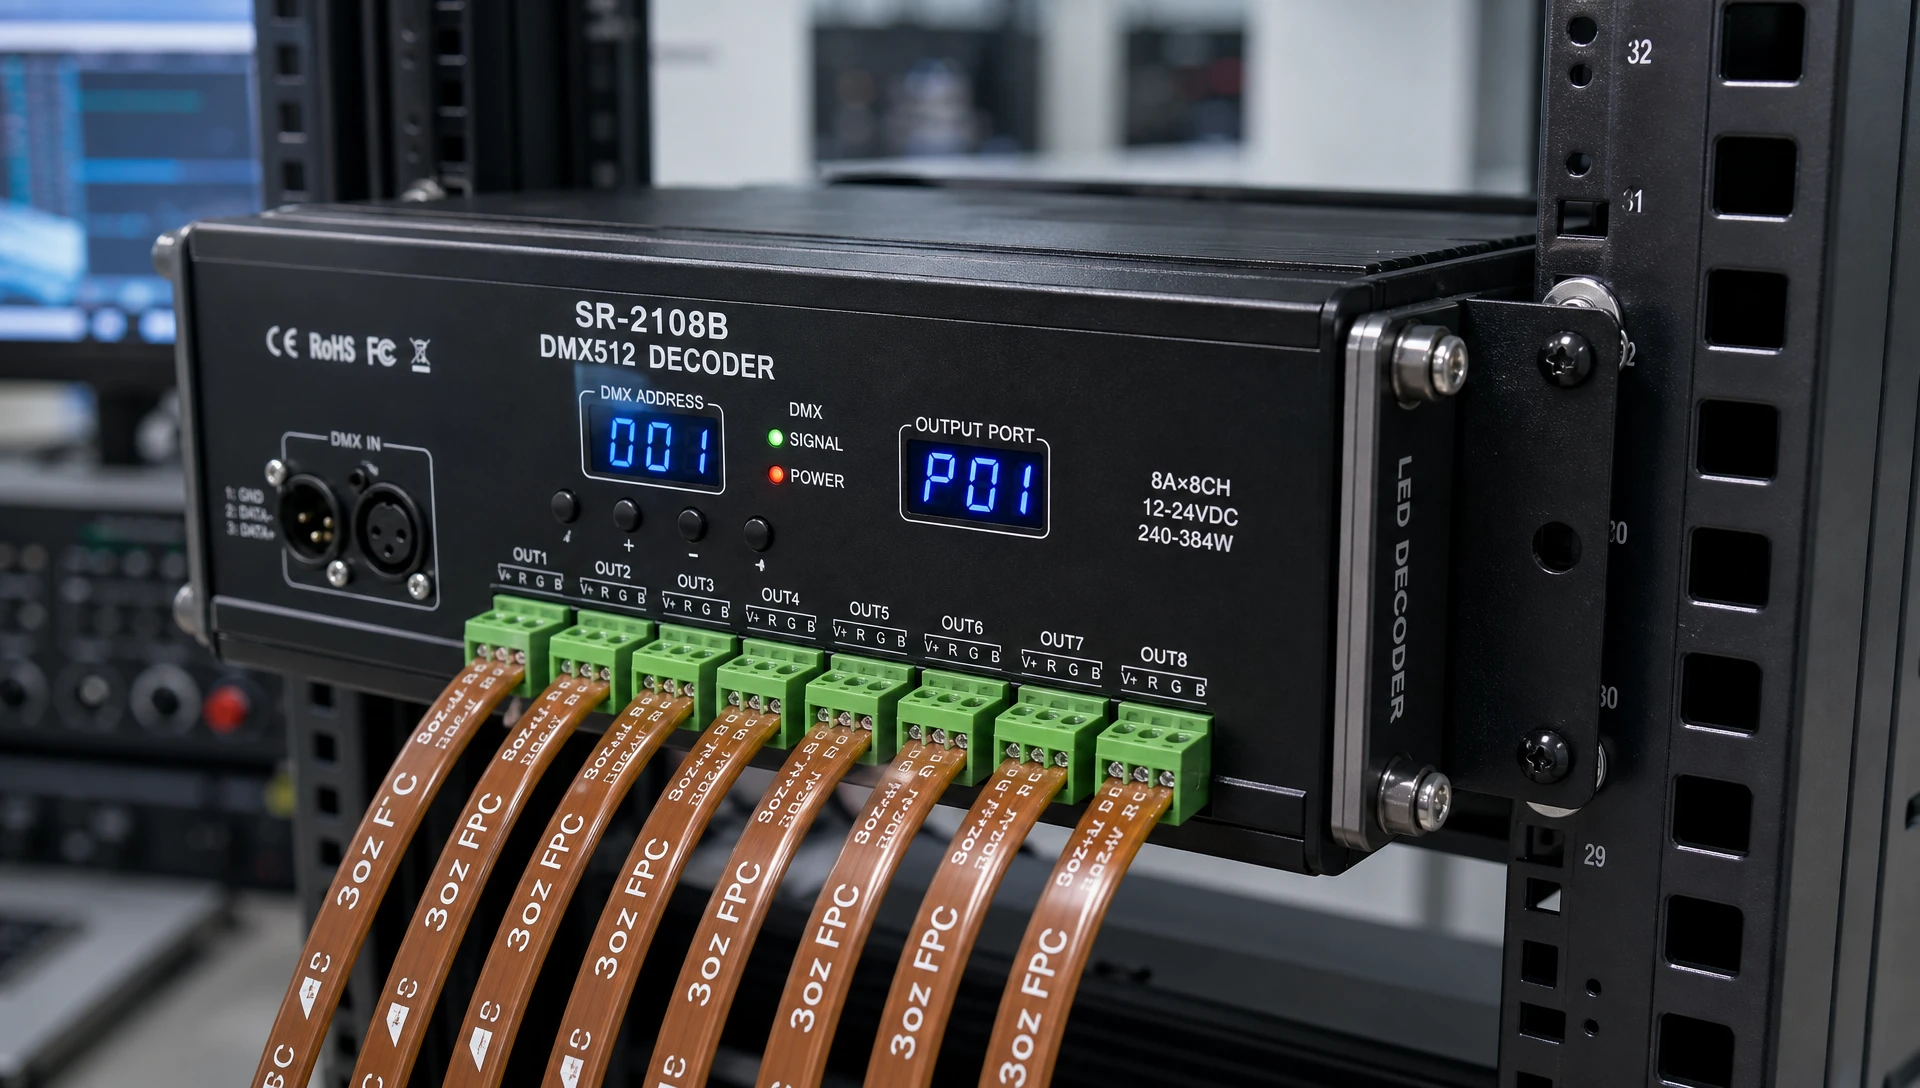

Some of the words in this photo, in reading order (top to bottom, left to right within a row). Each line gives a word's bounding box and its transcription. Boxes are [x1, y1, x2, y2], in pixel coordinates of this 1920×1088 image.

[1627, 39, 1652, 65] 32
[575, 300, 729, 340] SR-2108B
[266, 325, 298, 359] CE
[309, 332, 356, 363] RoHS
[540, 333, 636, 367] DMX512
[649, 344, 776, 381] DECODER
[600, 385, 632, 402] DMX
[636, 389, 704, 410] ADDRESS
[789, 401, 824, 420] DMX
[330, 431, 362, 449] DMX
[367, 435, 381, 451] IN
[789, 432, 844, 452] SIGNAL
[915, 416, 983, 439] OUTPUT
[988, 424, 1035, 444] PORT
[609, 417, 709, 475] 001
[790, 468, 845, 489] POWER
[923, 452, 1032, 515] P01
[1397, 455, 1412, 528] LED
[1143, 497, 1239, 527] 12-24VDC
[1138, 524, 1234, 553] 240-384W
[513, 547, 547, 565] OUT1
[519, 572, 527, 585] R
[536, 575, 545, 588] G
[555, 579, 563, 591] B
[595, 561, 631, 579] OUT2
[601, 586, 609, 598] R
[619, 589, 627, 601] G
[638, 592, 645, 604] B
[678, 574, 714, 592] OUT3
[684, 600, 692, 612] R
[702, 603, 711, 615] G
[721, 606, 729, 618] B
[761, 587, 800, 606] OUT4
[746, 611, 760, 623] V+
[768, 614, 777, 627] R
[787, 617, 796, 630] G
[807, 620, 815, 633] B
[850, 601, 890, 620] OUT5
[833, 625, 847, 637] V+
[857, 629, 866, 641] R
[876, 632, 886, 644] G
[897, 635, 906, 647] B
[942, 615, 983, 635] OUT6
[1390, 539, 1410, 724] DECODER
[924, 640, 939, 652] V+
[949, 643, 958, 656] R
[969, 647, 979, 660] G
[991, 650, 1000, 663] B
[1040, 630, 1085, 651] OUT7
[1021, 655, 1037, 669] V+
[1047, 659, 1057, 673] R
[1068, 663, 1079, 676] G
[1091, 666, 1100, 680] B
[1140, 646, 1188, 668] OUT8
[1121, 672, 1138, 685] V+
[1148, 676, 1158, 690] R
[1171, 679, 1182, 693] G
[1195, 683, 1206, 697] B
[337, 835, 385, 910] 3oz
[373, 771, 418, 827] FC
[425, 858, 471, 932] 3oz
[458, 792, 503, 850] FPC
[1584, 843, 1606, 868] 29
[507, 879, 553, 953] 3oz
[540, 813, 584, 870] FPC
[594, 907, 639, 980] 3oz
[625, 837, 670, 898] FPC
[688, 932, 730, 1007] 3oz
[716, 860, 761, 924] FPC
[790, 957, 832, 1033] 3oz
[815, 883, 860, 948] FPC
[890, 981, 932, 1061] 3oz
[913, 905, 958, 973] FPC
[999, 1007, 1042, 1088] 3oz
[1021, 927, 1067, 999] FPC
